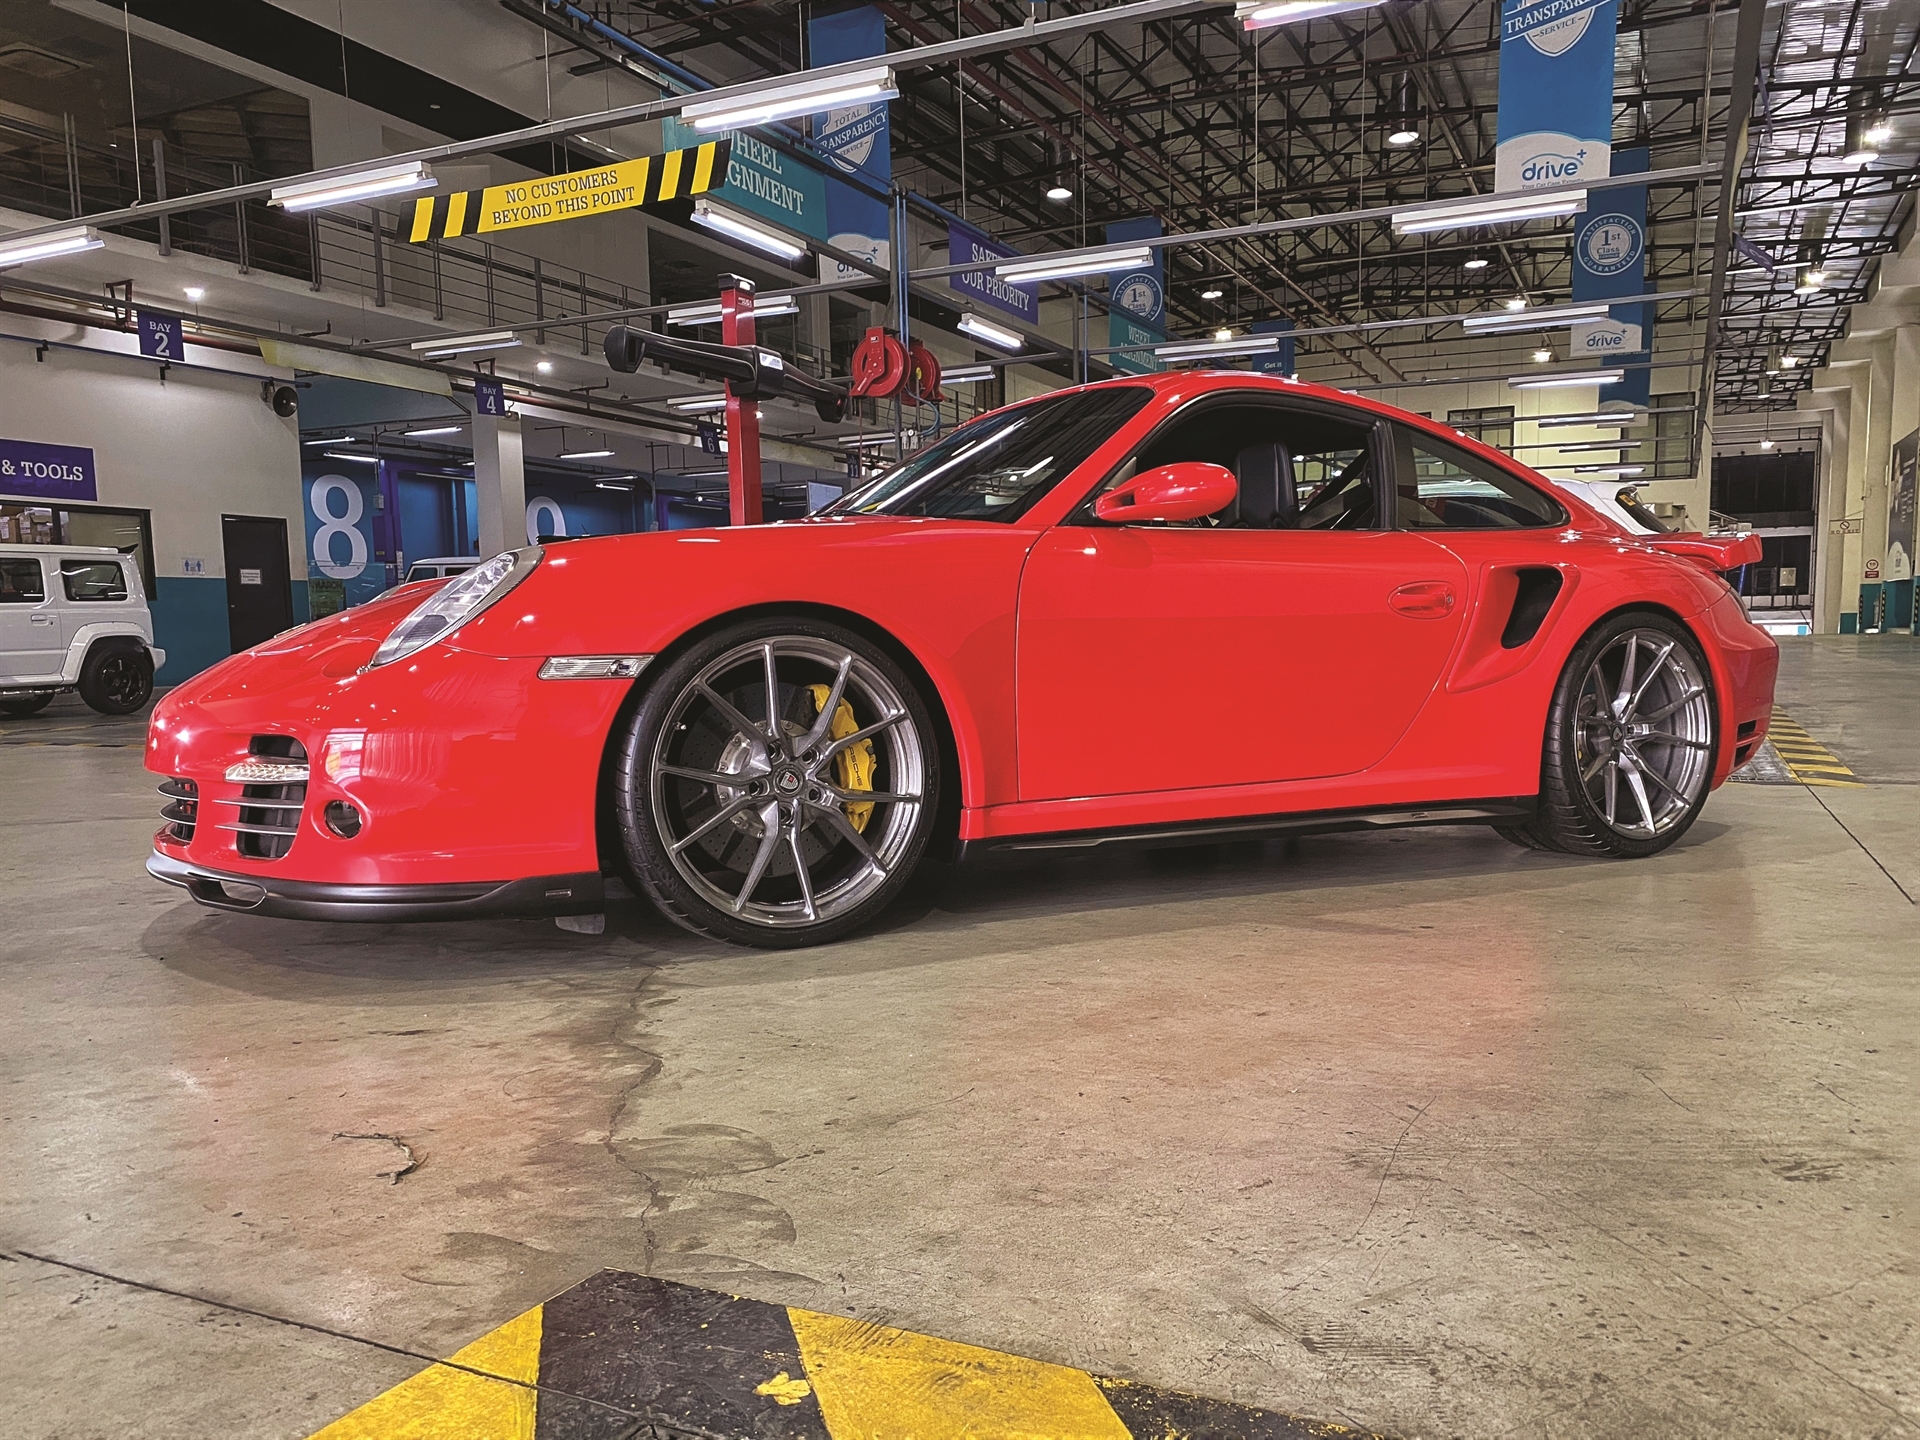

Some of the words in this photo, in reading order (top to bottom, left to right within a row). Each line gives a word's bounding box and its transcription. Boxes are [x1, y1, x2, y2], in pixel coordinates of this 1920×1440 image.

[1540, 17, 1577, 37] SERVICE
[834, 109, 862, 128] TOTAL
[818, 110, 887, 154] RANSPARENCY
[505, 187, 527, 204] NO
[531, 169, 618, 199] CUSTOMERS
[492, 202, 552, 225] BEYOND
[556, 194, 589, 214] THIS
[592, 186, 635, 208] POINT
[986, 275, 1030, 311] PRIORITY
[149, 321, 171, 333] BAY
[155, 332, 169, 356] 2
[482, 387, 497, 395] BAY
[486, 396, 496, 413] 4
[707, 438, 715, 452] 6
[2, 459, 16, 475] &
[21, 461, 83, 481] TOOLS
[310, 474, 368, 579] 8
